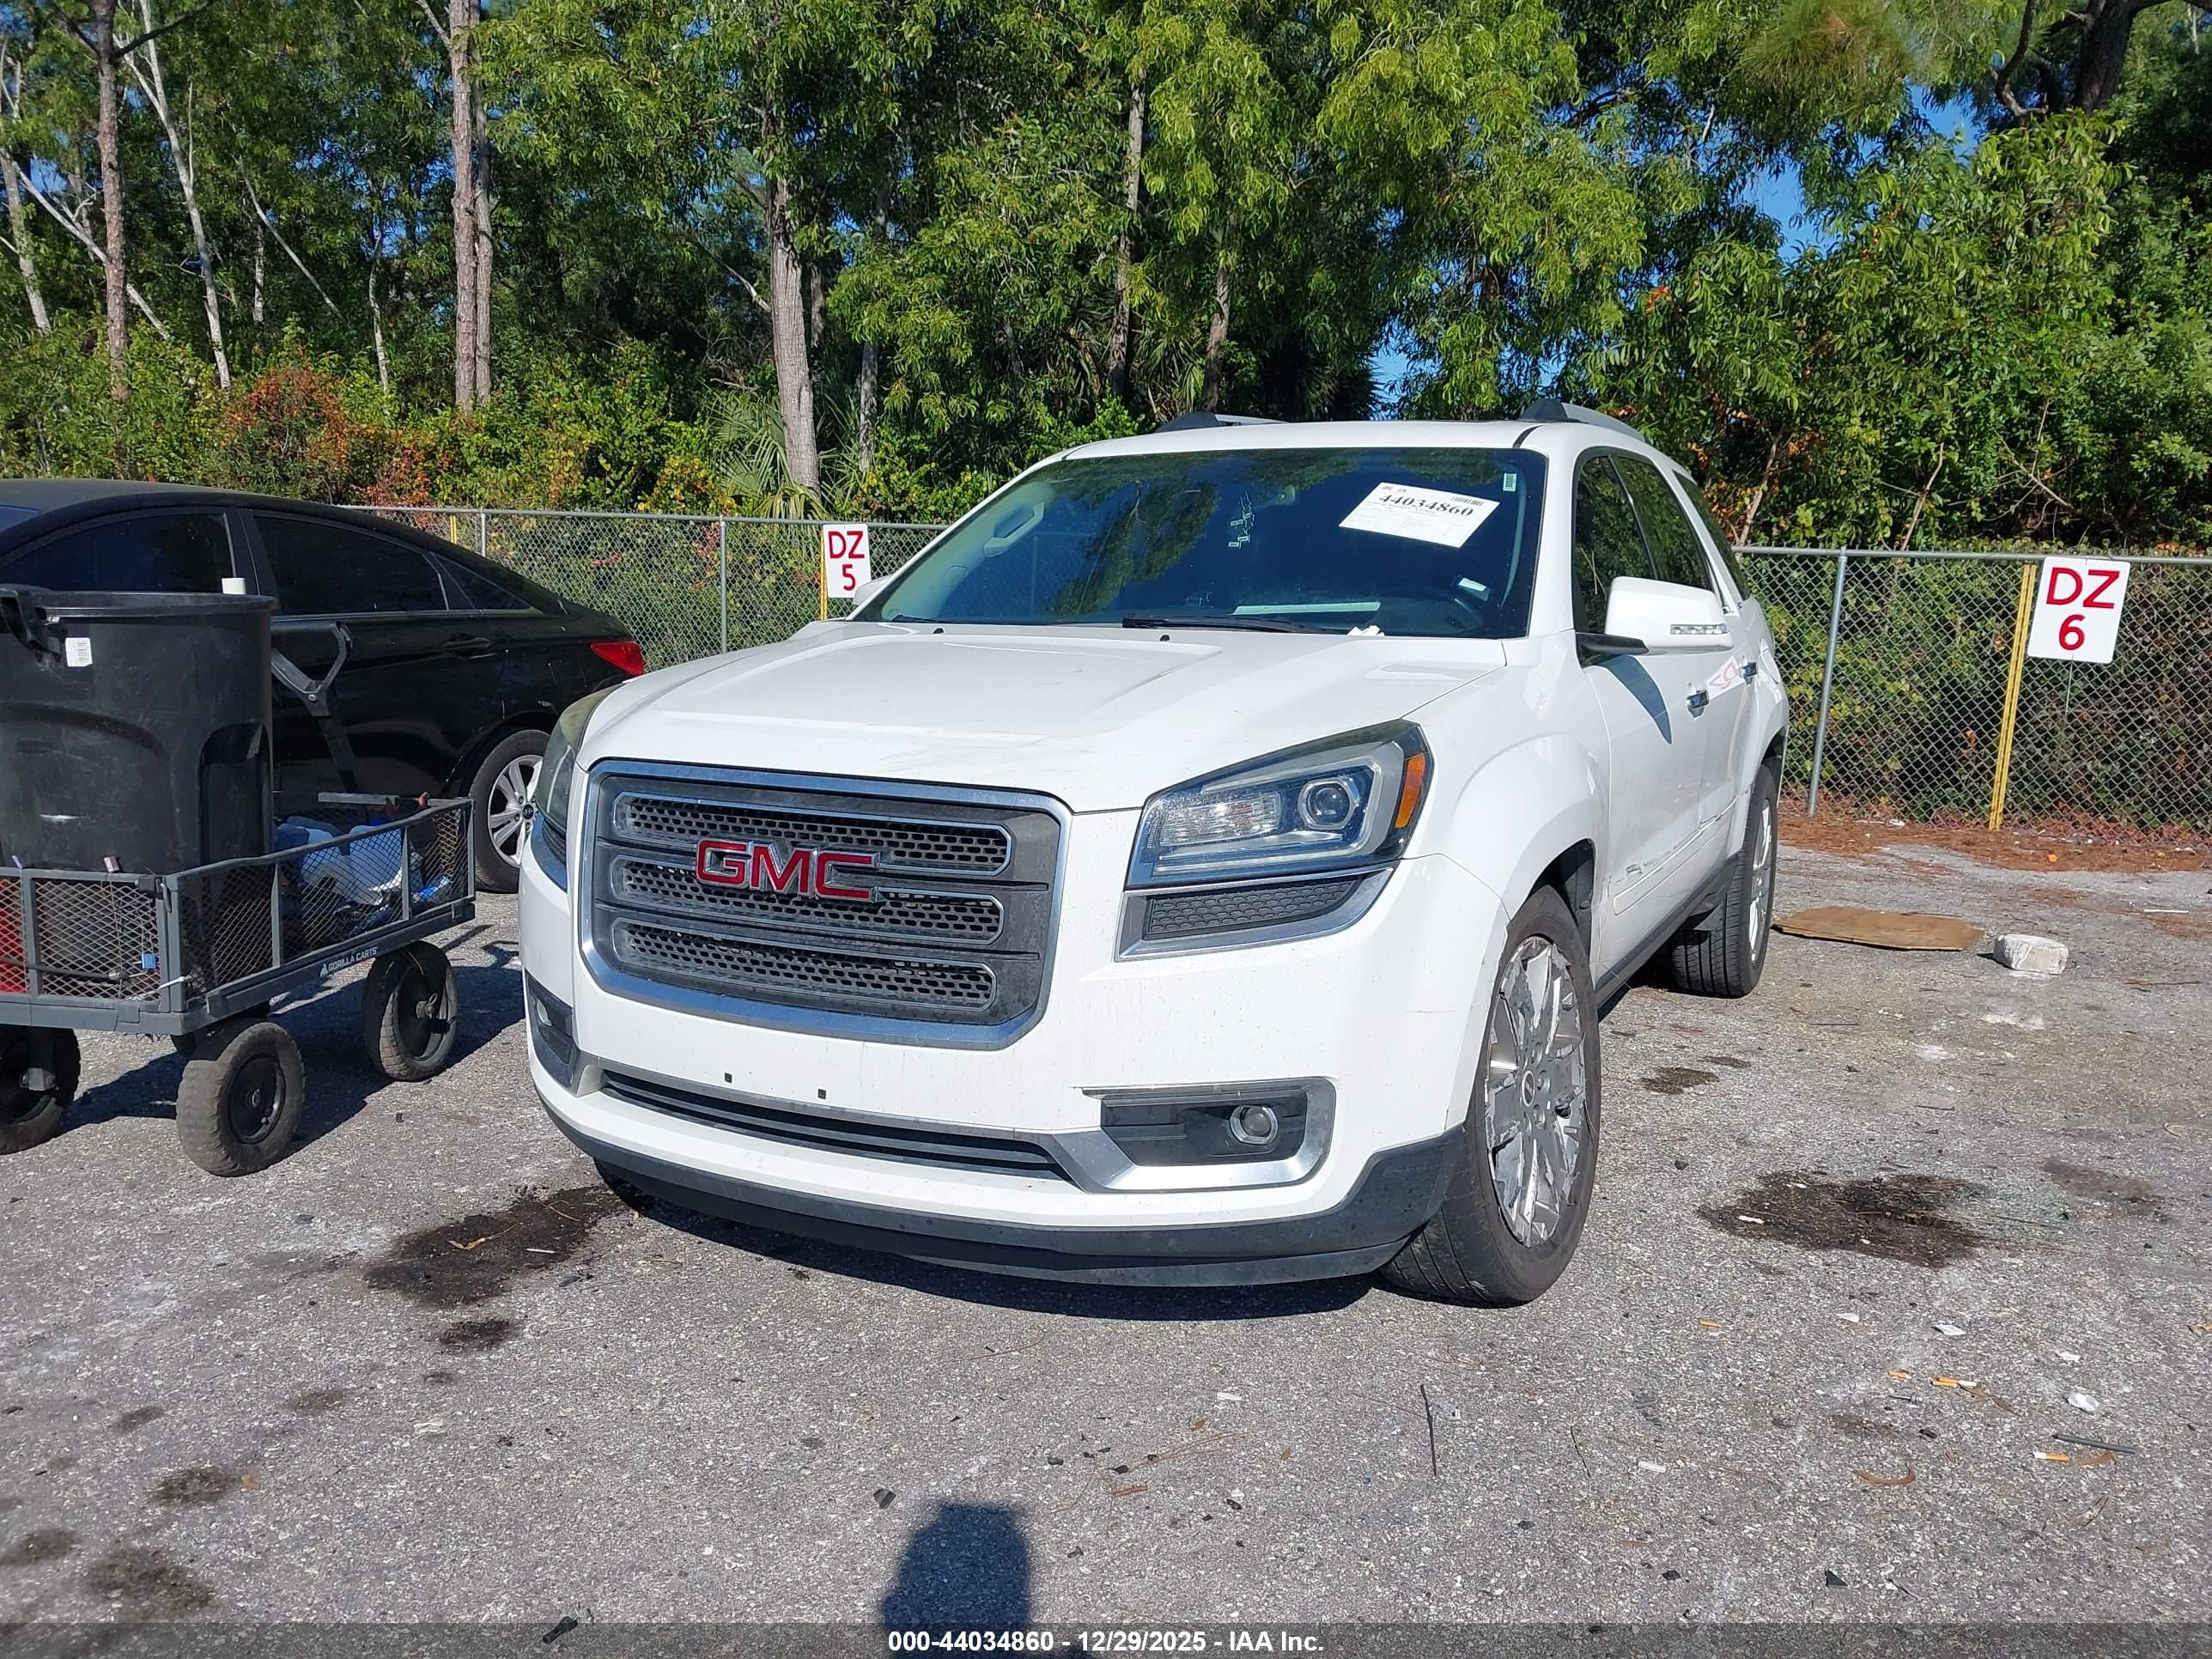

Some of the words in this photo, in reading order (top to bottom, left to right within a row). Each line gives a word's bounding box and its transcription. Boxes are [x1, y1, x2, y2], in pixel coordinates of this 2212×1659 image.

[1379, 494, 1474, 516] 44034860
[828, 531, 865, 559] DZ
[842, 564, 856, 591] 5
[2046, 567, 2120, 609] DZ
[2058, 614, 2086, 650] 6
[696, 839, 879, 902] GMC
[328, 955, 356, 971] GORILLA
[356, 947, 377, 961] CARTS
